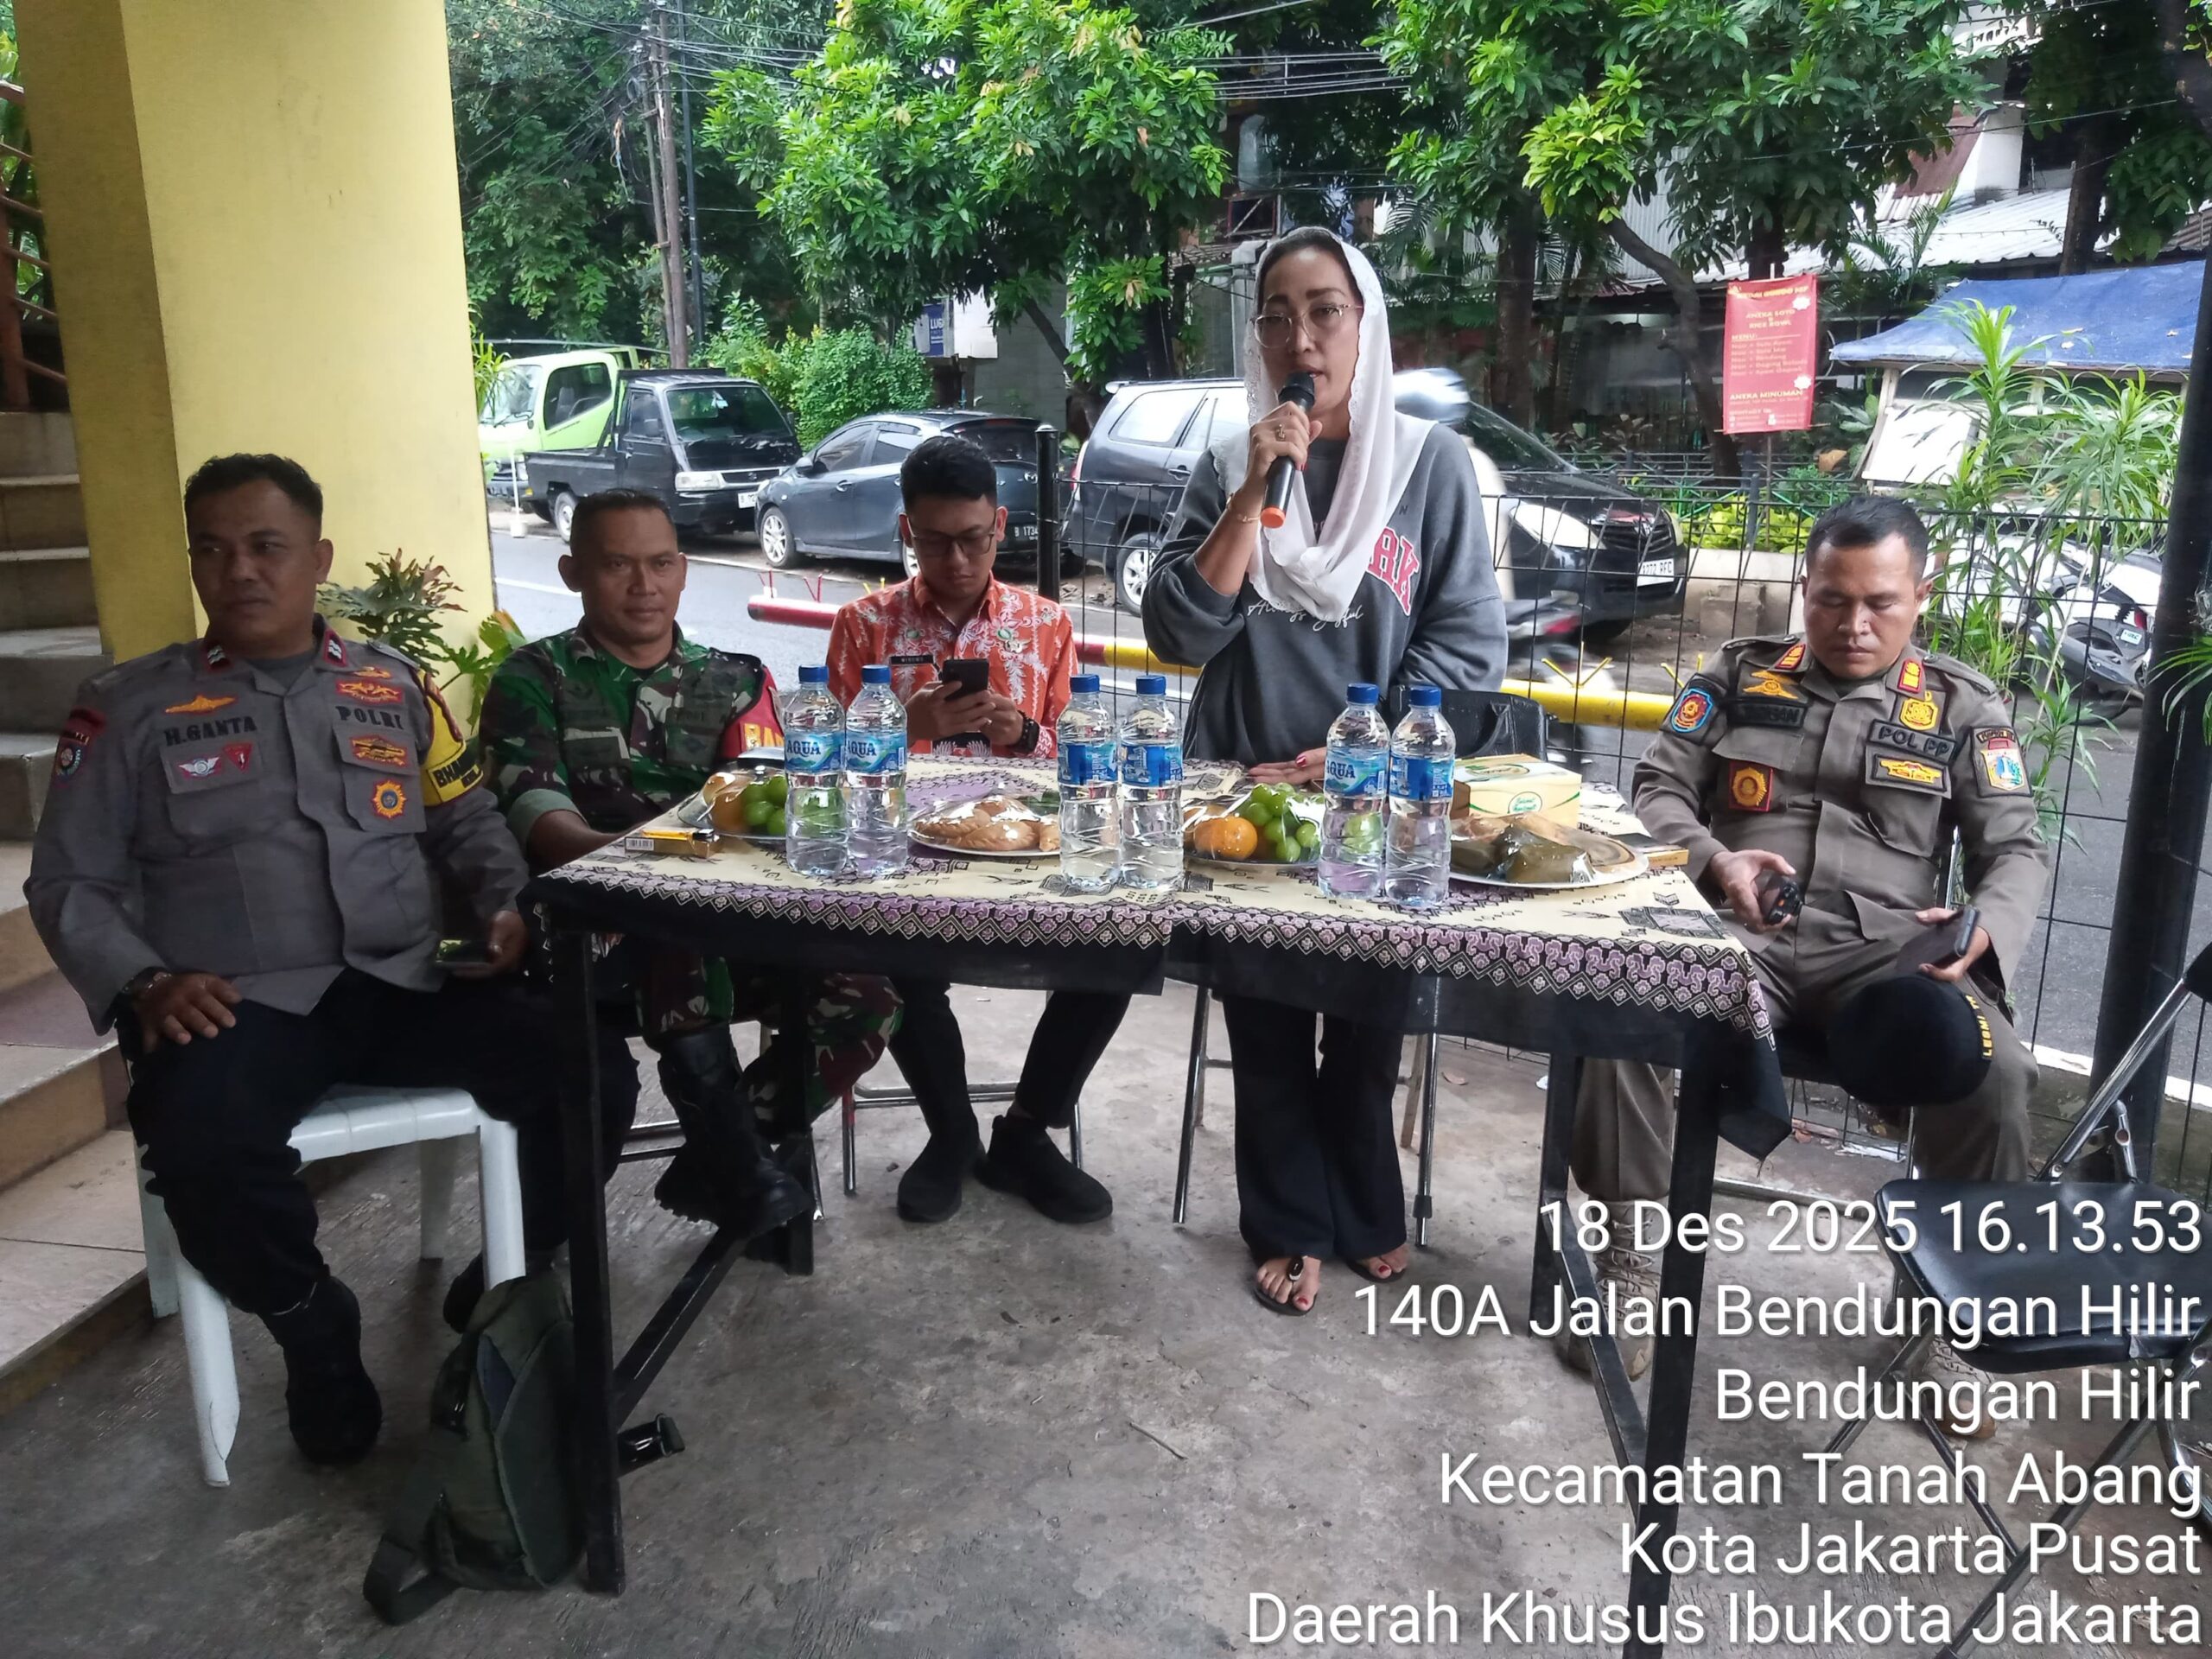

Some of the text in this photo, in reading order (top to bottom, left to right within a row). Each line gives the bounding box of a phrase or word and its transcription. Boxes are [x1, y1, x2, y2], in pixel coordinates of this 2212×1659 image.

[1759, 390, 1803, 398] MINUMAN
[335, 705, 404, 730] POLRI
[786, 740, 821, 758] AQUA
[1878, 725, 1950, 757] POL PP
